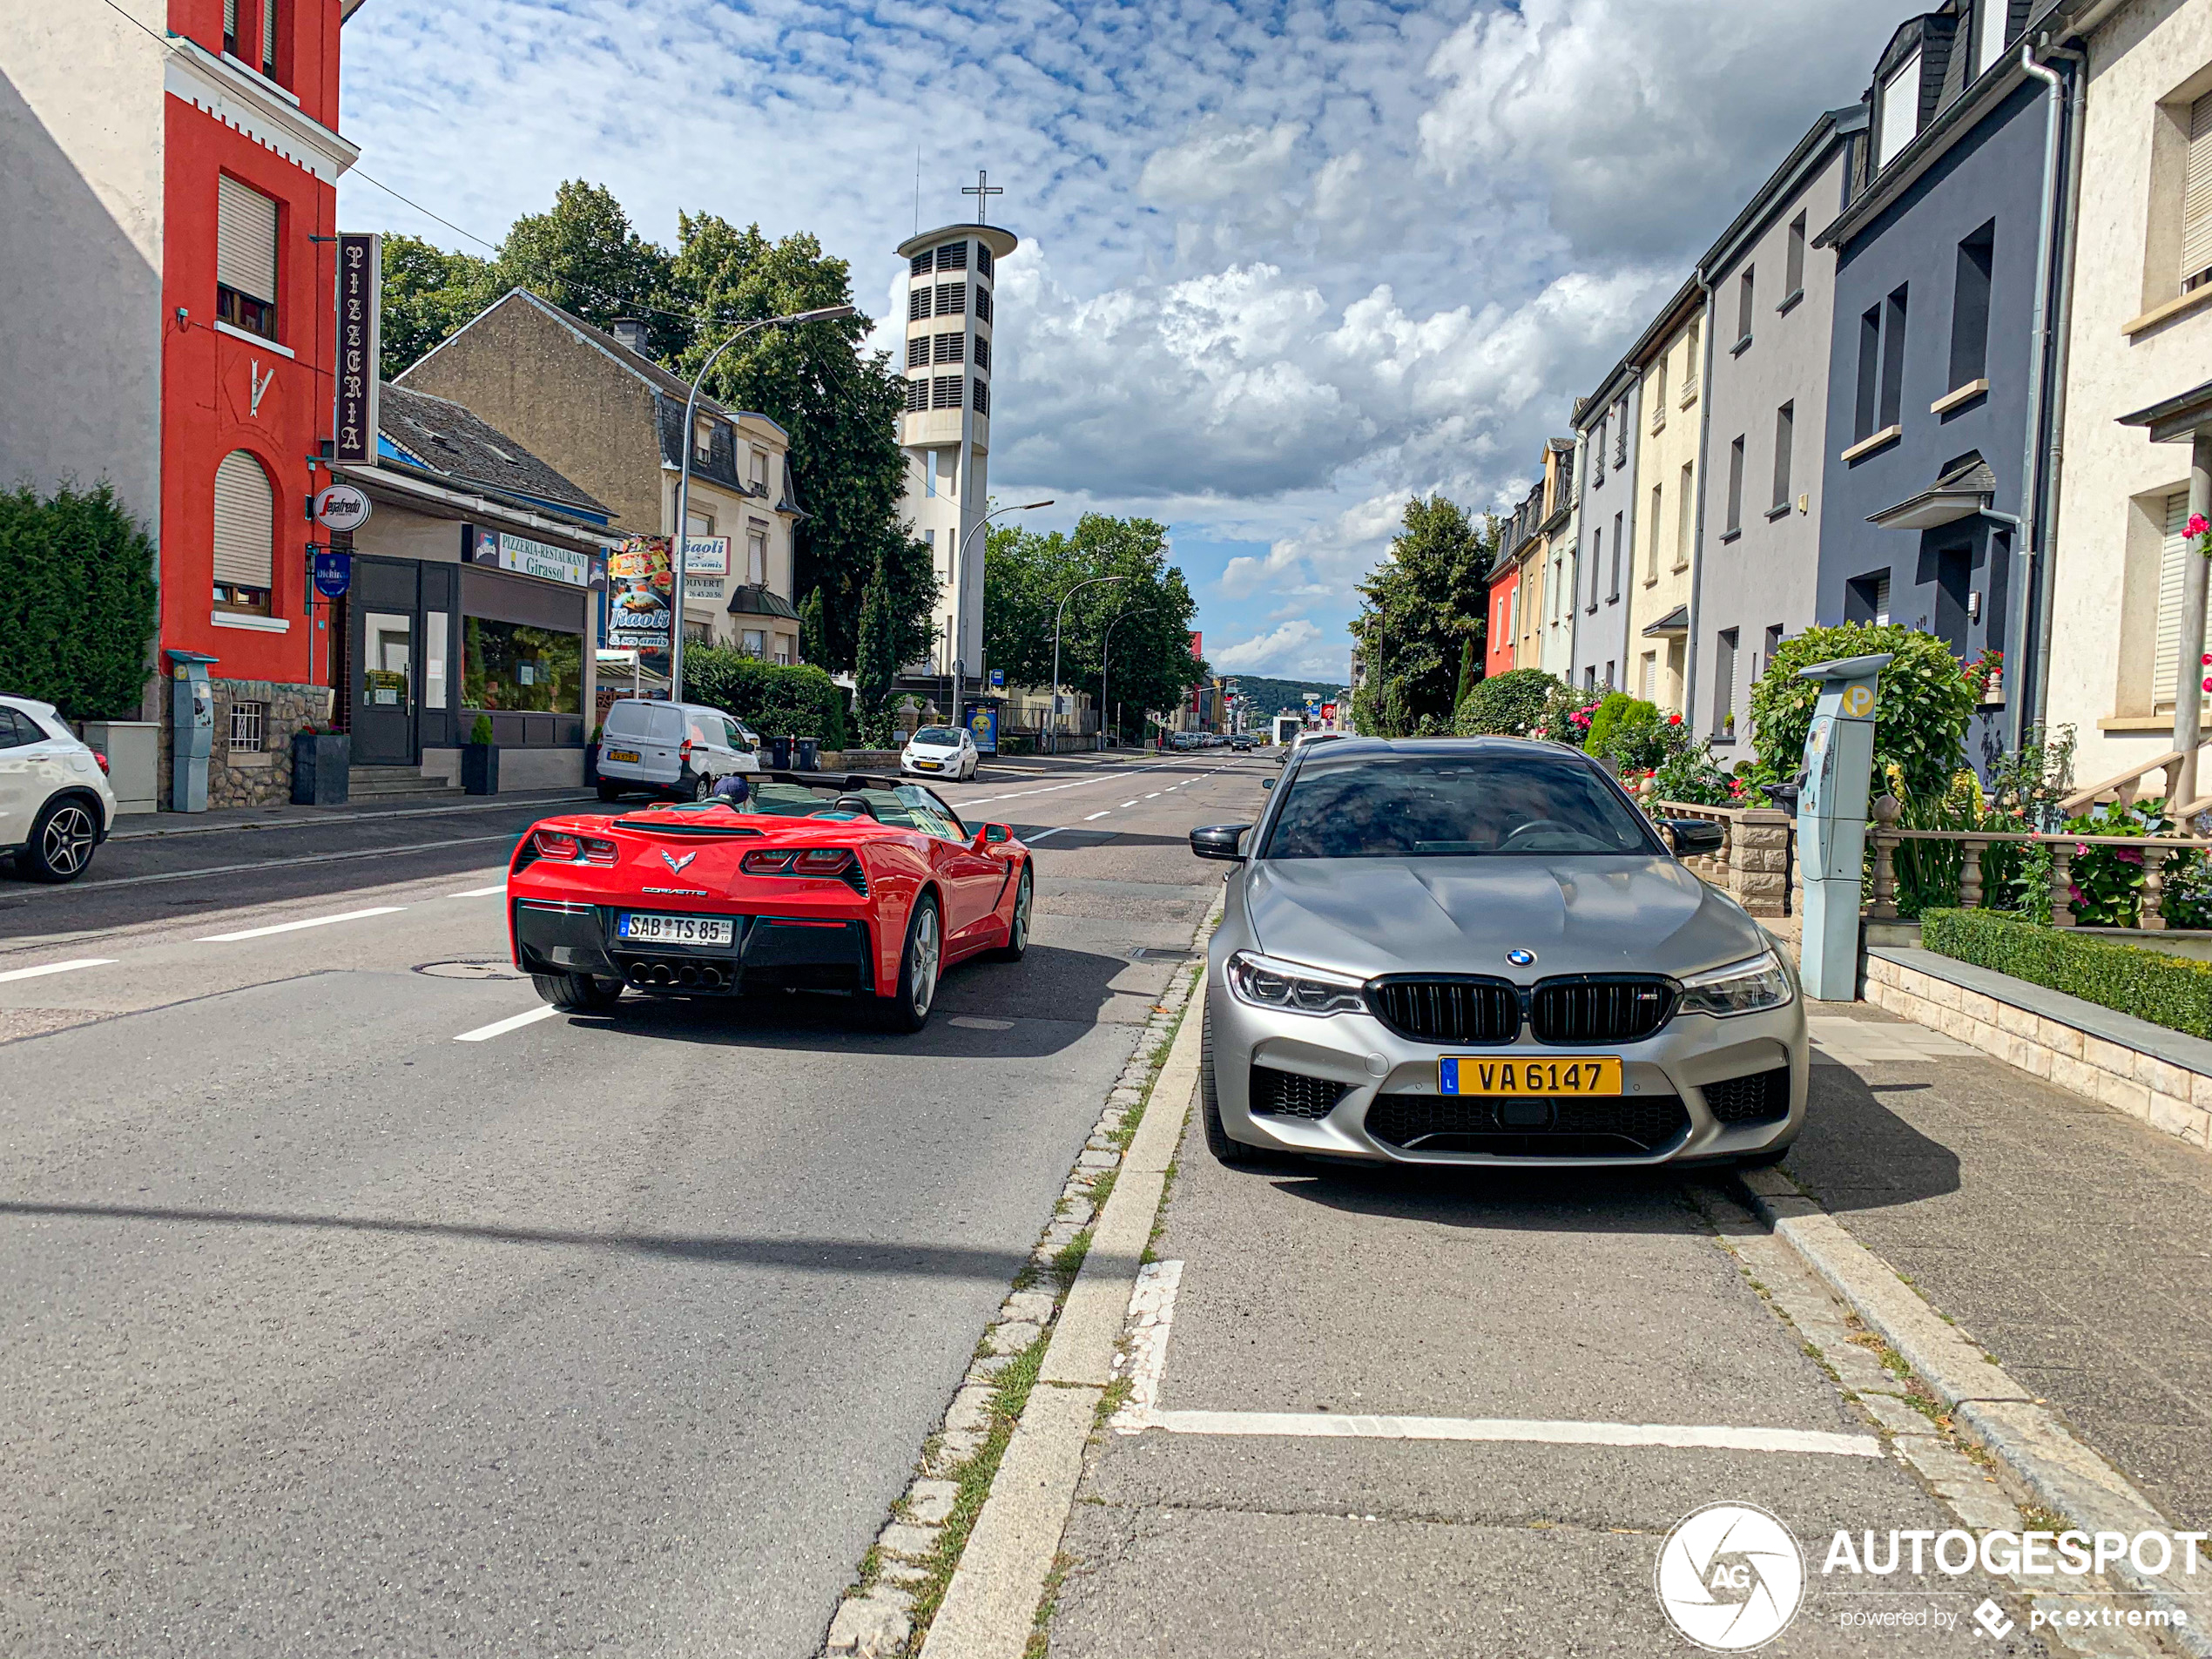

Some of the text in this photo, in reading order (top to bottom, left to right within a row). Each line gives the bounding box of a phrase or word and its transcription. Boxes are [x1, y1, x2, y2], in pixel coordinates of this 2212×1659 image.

[341, 246, 364, 450] PIZZERIA
[319, 494, 361, 516] Segafredo
[502, 534, 586, 568] PIZZERIA-RESTAURANT
[526, 556, 565, 581] Girassol
[609, 608, 671, 630] Jiaoli
[639, 636, 669, 647] amis
[1851, 688, 1871, 714] P
[630, 917, 720, 941] SAB TS 85
[1447, 1079, 1453, 1089] L
[1478, 1063, 1602, 1090] VA 6147
